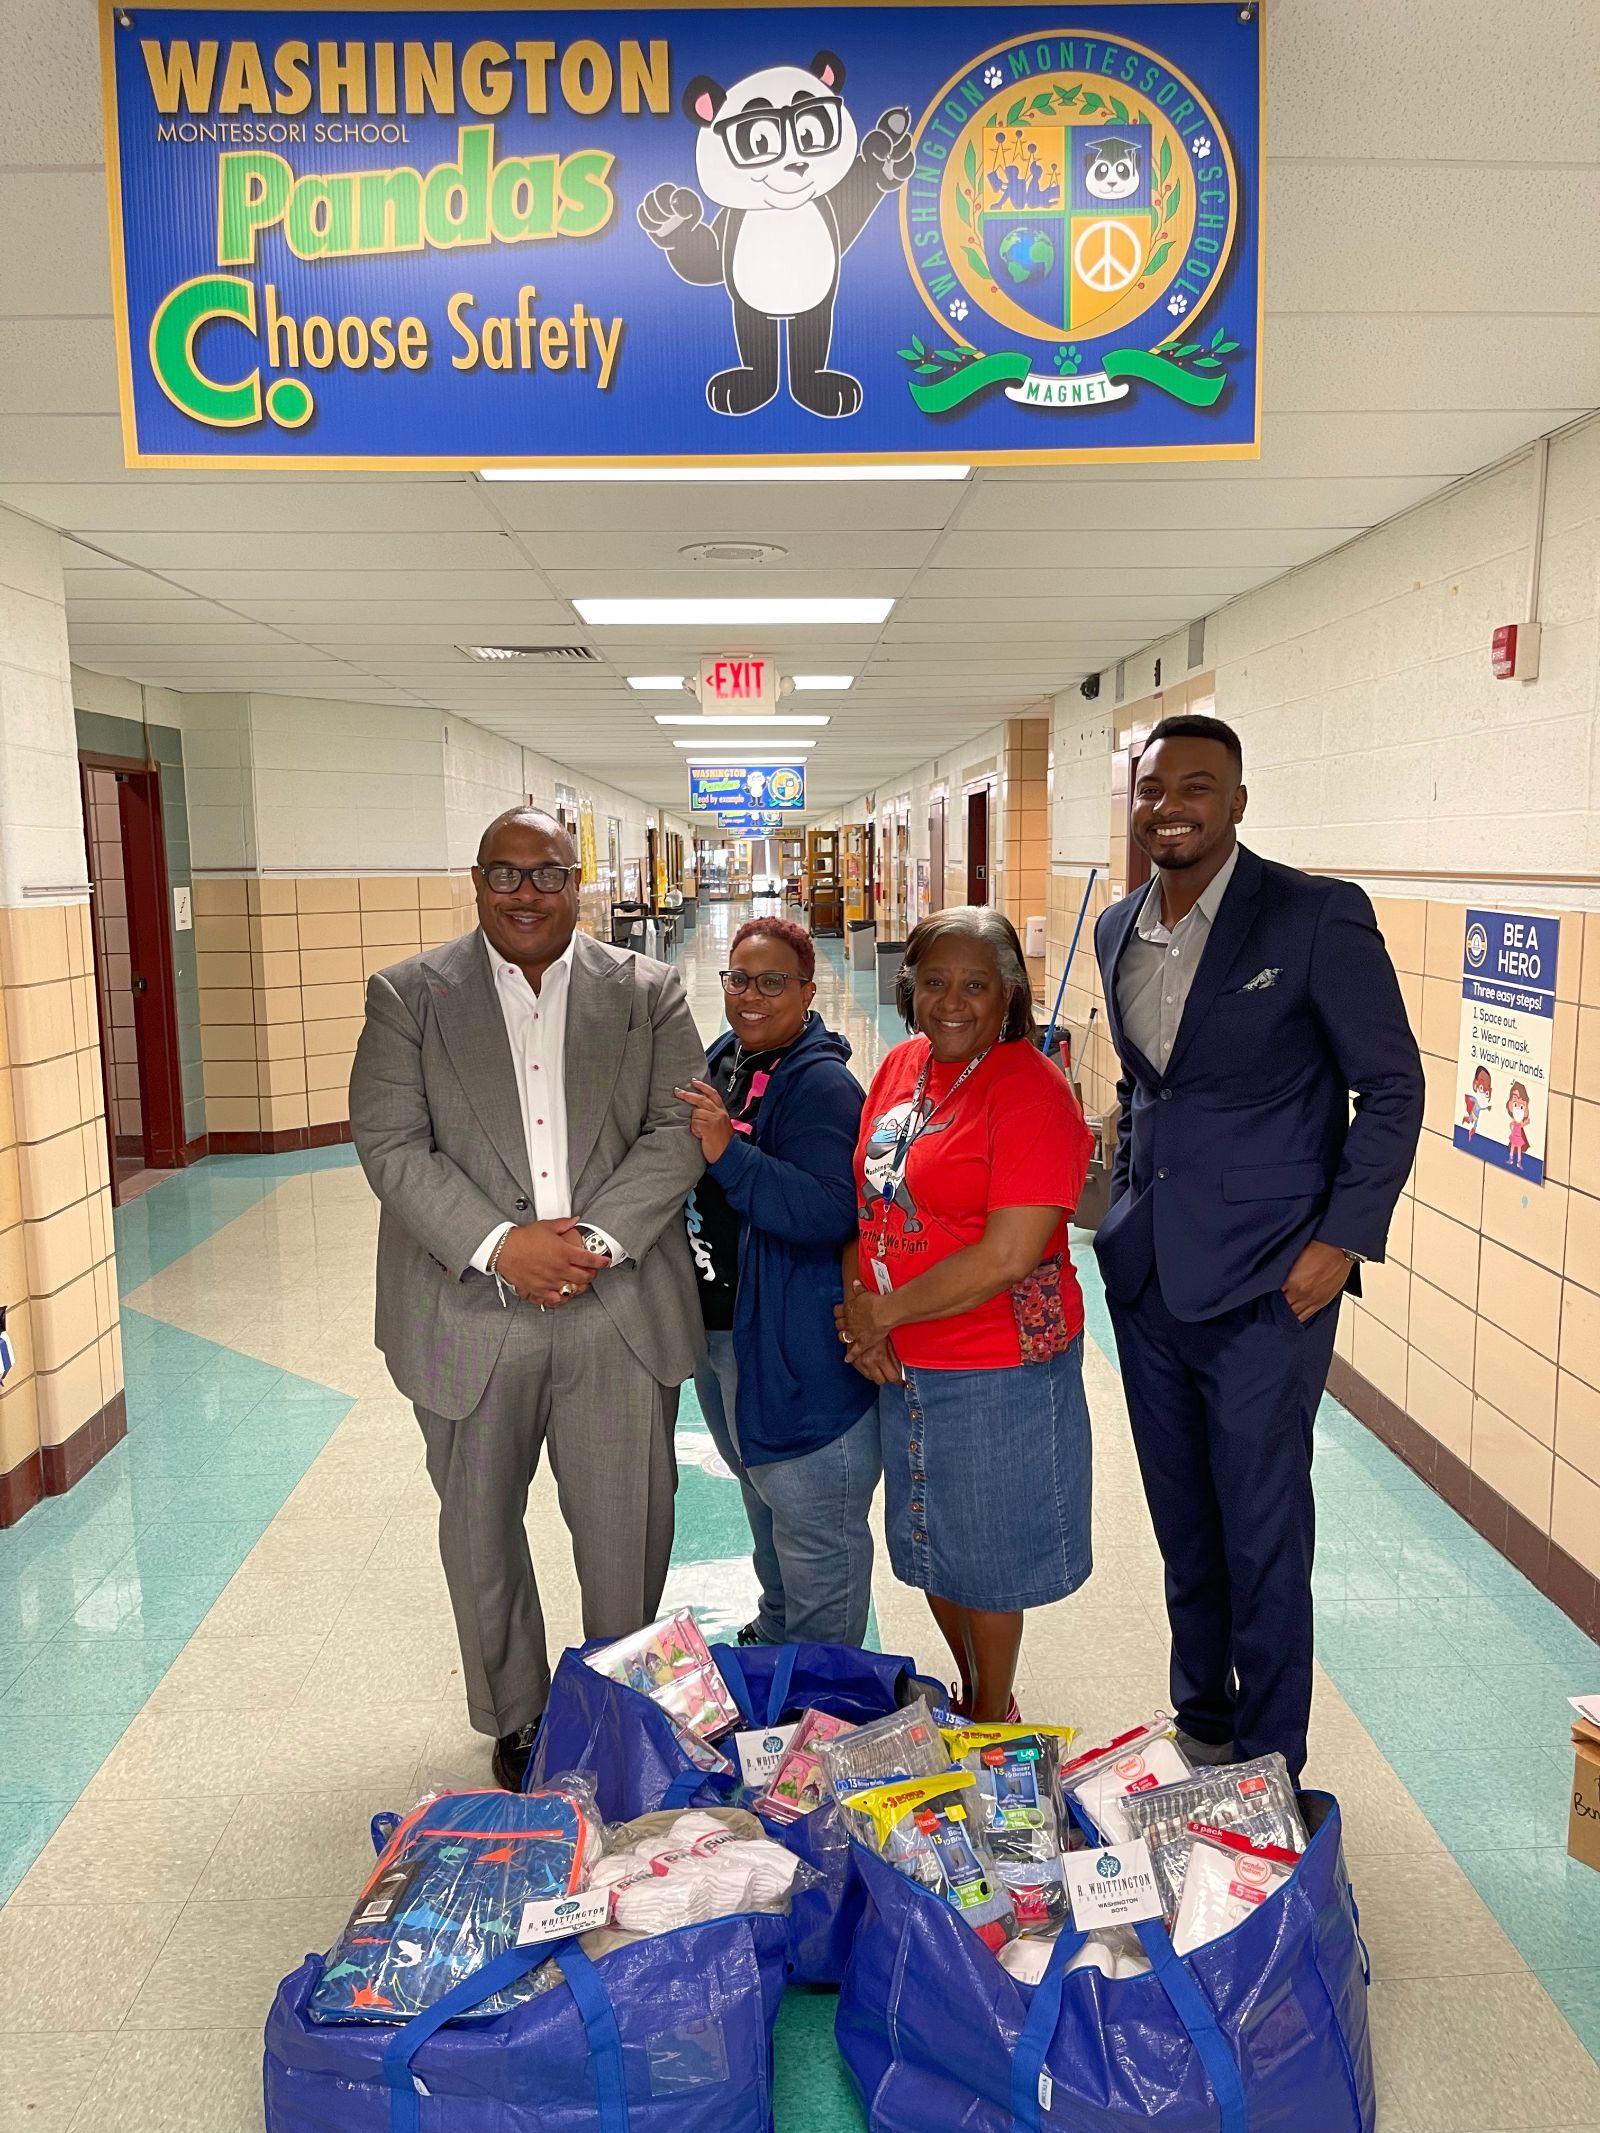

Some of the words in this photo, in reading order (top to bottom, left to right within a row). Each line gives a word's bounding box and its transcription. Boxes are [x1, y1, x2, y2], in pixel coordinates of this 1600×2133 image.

[140, 40, 671, 115] WASHINGTON
[1007, 41, 1205, 137] MONTESSORI
[156, 123, 307, 144] MONTESSORI
[313, 123, 410, 144] SCHOOL
[217, 124, 615, 266] Pandas
[911, 79, 985, 300] WASHINGTON
[1173, 165, 1226, 296] SCHOOL
[447, 285, 623, 390] Safety
[1026, 380, 1108, 404] MAGNET
[715, 662, 764, 698] EXIT
[692, 768, 746, 778] WASHINGTON
[1504, 922, 1524, 947] BE
[1525, 926, 1538, 950] A
[1498, 949, 1540, 979] HERO
[1473, 981, 1495, 999] Three
[1496, 990, 1515, 1007] easy
[1516, 993, 1543, 1011] steps!
[1480, 1008, 1502, 1024] Space
[1503, 1017, 1518, 1029] out.
[1481, 1028, 1500, 1044] Wear
[1502, 1037, 1506, 1046] a
[1508, 1040, 1530, 1053] mask.
[1471, 1045, 1478, 1058] 3.
[1480, 1047, 1499, 1064] Wash
[1501, 1057, 1518, 1070] your
[1519, 1060, 1545, 1079] hands.
[901, 1237, 928, 1254] Fight
[946, 1713, 955, 1724] 13
[848, 1778, 858, 1788] 13
[932, 1834, 942, 1845] 13
[1201, 1827, 1223, 1836] pack
[1089, 1873, 1151, 1897] WHITTINGTON
[1236, 1886, 1244, 1897] 5
[1098, 1897, 1139, 1909] WASHINGTON
[541, 1906, 605, 1927] WHITTINGTON
